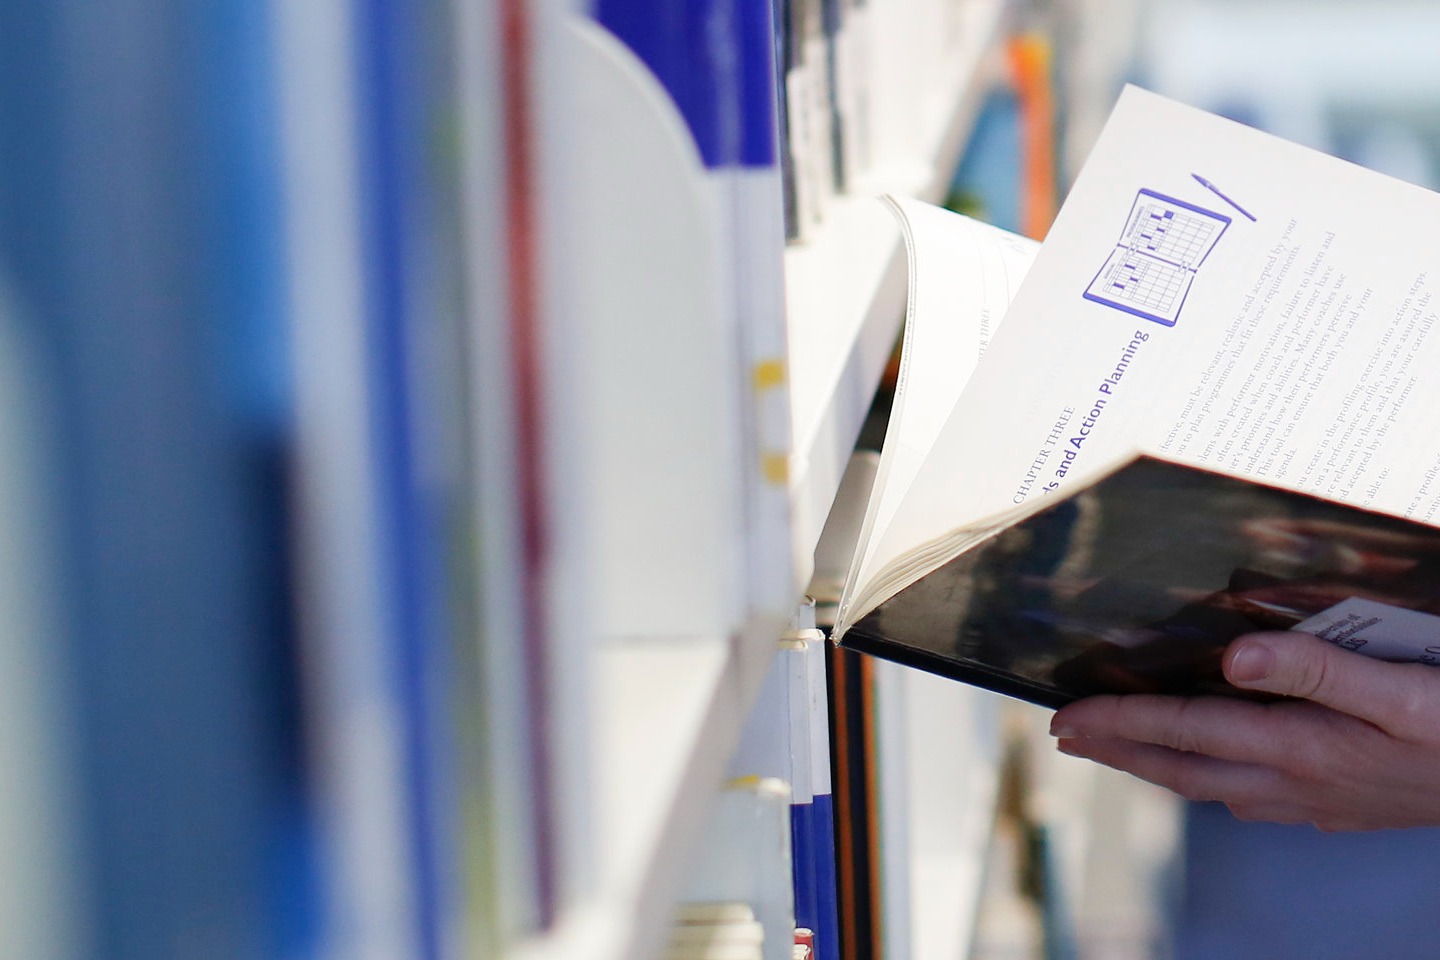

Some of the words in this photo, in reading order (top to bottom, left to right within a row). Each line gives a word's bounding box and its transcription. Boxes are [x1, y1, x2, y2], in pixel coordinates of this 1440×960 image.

[1179, 397, 1198, 420] must
[1199, 348, 1228, 385] relevant,
[1221, 313, 1246, 348] realistic
[1251, 254, 1278, 295] accepted
[1281, 218, 1298, 242] your
[1188, 413, 1206, 434] plan
[1201, 359, 1237, 414] programmes
[1229, 340, 1248, 359] that
[1247, 304, 1267, 328] these
[1263, 244, 1302, 305] requirements.
[1212, 418, 1230, 438] with
[1226, 372, 1256, 419] performer
[1252, 321, 1288, 372] motivation,
[1279, 289, 1304, 320] failure
[1302, 250, 1326, 277] listen
[1321, 230, 1336, 250] and
[1216, 439, 1235, 463] often
[1230, 405, 1254, 439] created
[1249, 381, 1269, 406] when
[1265, 354, 1285, 381] coach
[1290, 288, 1321, 337] performer
[1313, 265, 1335, 288] have
[1240, 412, 1268, 452] priorities
[1264, 392, 1279, 411] and
[1273, 356, 1301, 393] abilities.
[1293, 327, 1318, 355] Many
[1313, 291, 1338, 327] coaches
[1268, 405, 1288, 426] how
[1282, 383, 1302, 405] their
[1297, 333, 1331, 384] performers
[1326, 294, 1353, 334] perceive
[1270, 437, 1286, 457] tool
[1292, 391, 1314, 421] ensure
[1307, 372, 1325, 391] that
[1317, 350, 1339, 372] both
[1333, 330, 1350, 350] you
[1355, 287, 1374, 312] your
[1304, 449, 1324, 476] create
[1335, 383, 1366, 424] profiling
[1359, 346, 1384, 383] exercise
[1376, 327, 1395, 347] into
[1391, 297, 1413, 327] action
[1408, 271, 1428, 297] steps.
[1326, 412, 1363, 468] performance
[1359, 380, 1384, 413] profile,
[1378, 359, 1394, 380] you
[1399, 307, 1423, 344] assured
[1417, 291, 1432, 308] the
[1332, 449, 1358, 484] relevant
[1358, 413, 1379, 437] them
[1375, 394, 1390, 413] and
[1383, 376, 1401, 395] that
[1396, 352, 1414, 377] your
[1411, 312, 1439, 352] carefully
[1012, 449, 1052, 505] CHAPTER
[1044, 407, 1076, 446] THREE
[1054, 449, 1078, 479] and
[1069, 399, 1107, 450] Action
[1098, 329, 1150, 396] Planning
[1274, 448, 1298, 480] agenda.
[1346, 450, 1373, 489] accepted
[1386, 375, 1419, 423] performer.
[1418, 465, 1440, 496] profile
[1365, 480, 1383, 499] able
